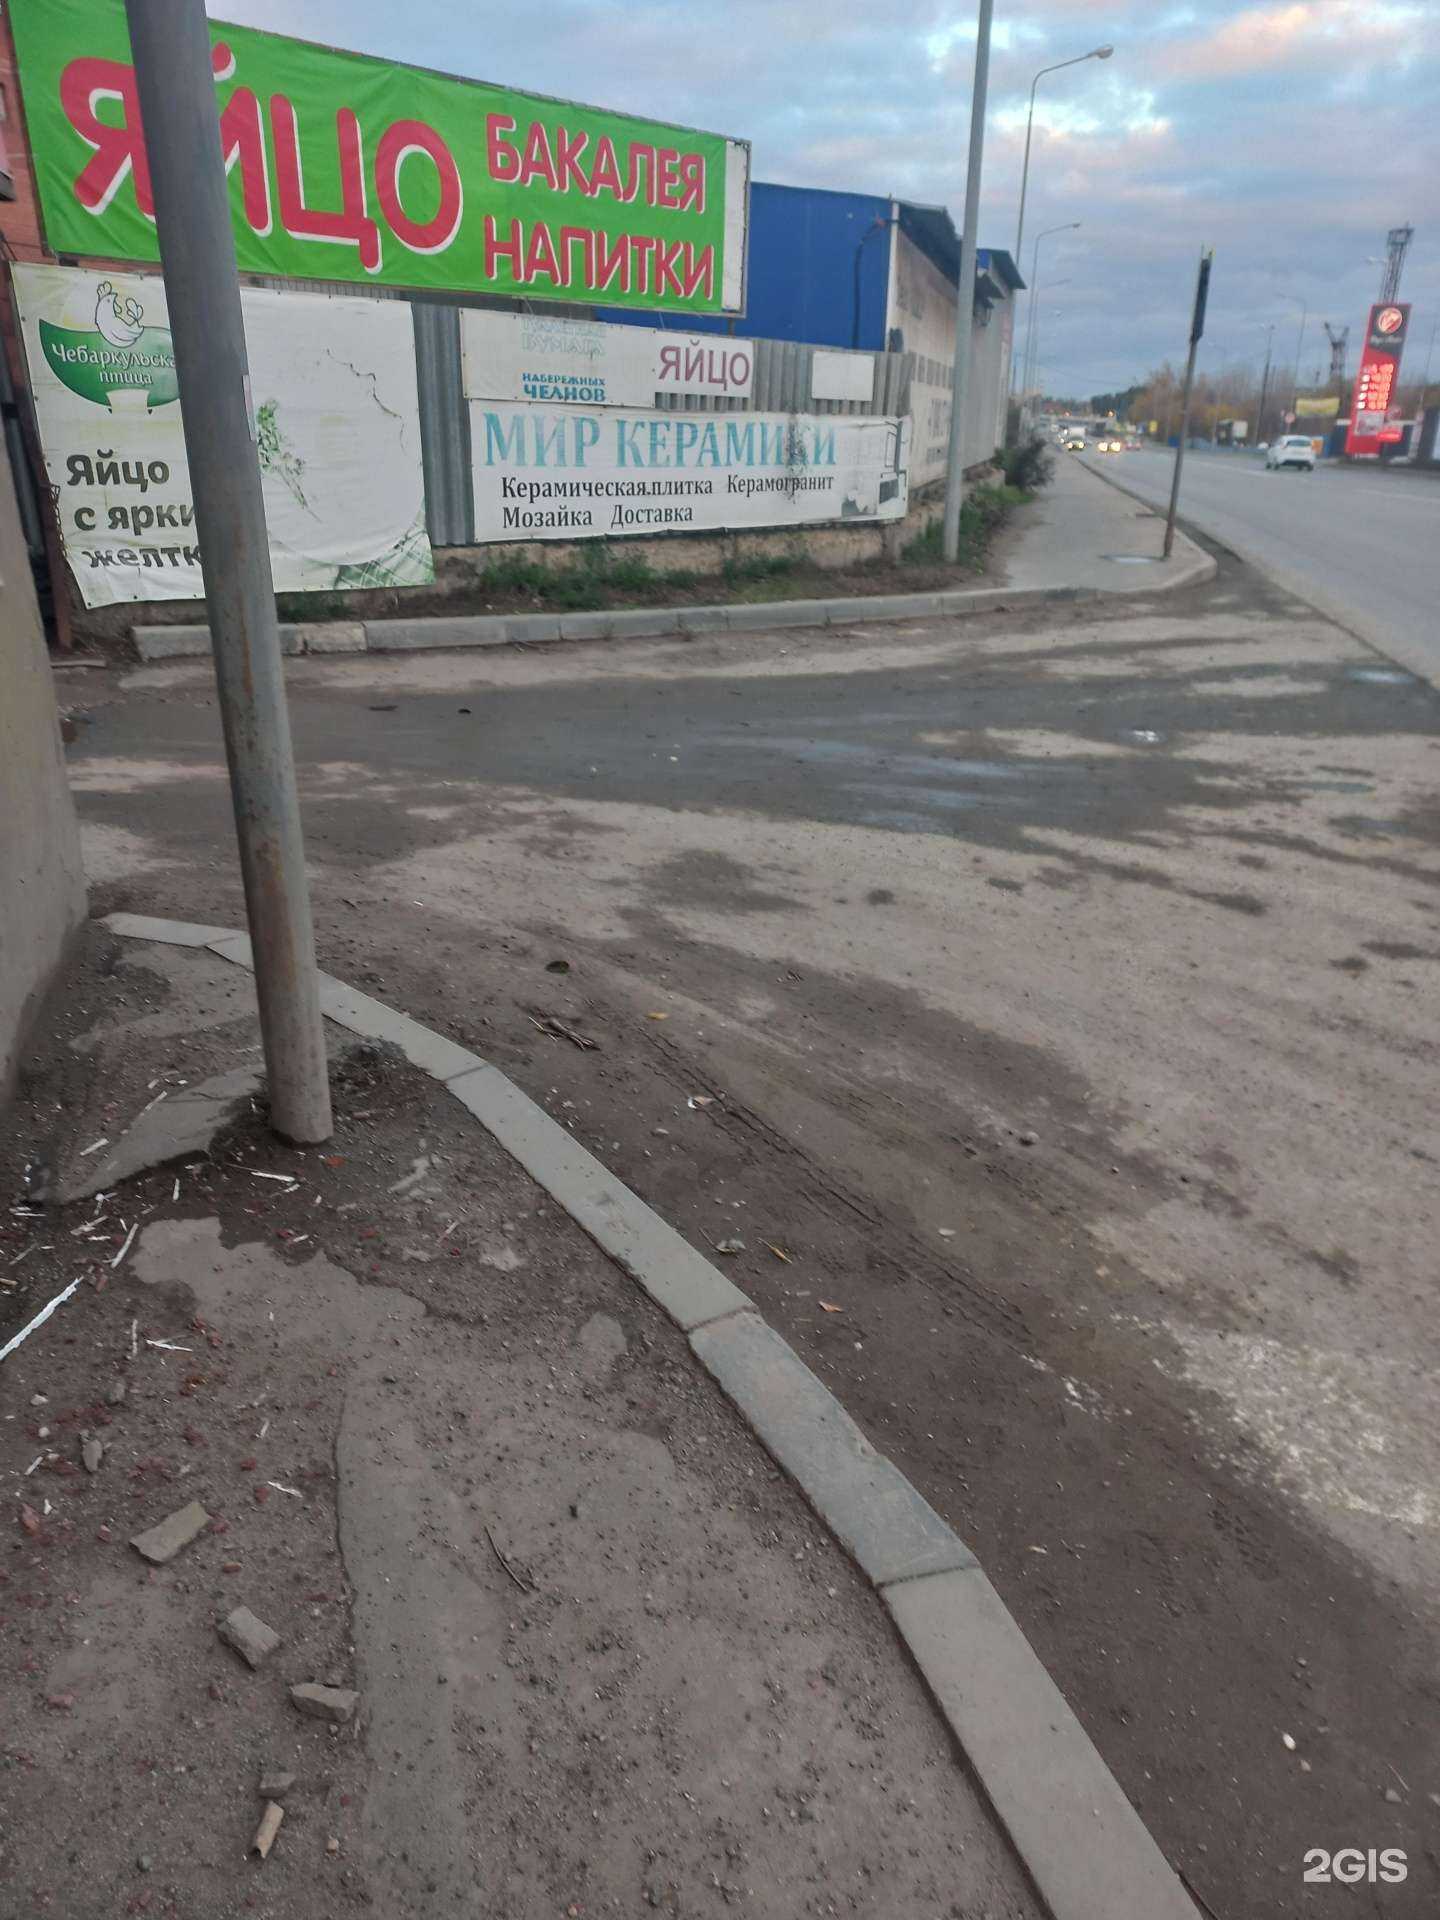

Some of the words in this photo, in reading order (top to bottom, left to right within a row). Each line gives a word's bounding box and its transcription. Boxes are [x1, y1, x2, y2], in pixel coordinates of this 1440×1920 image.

[486, 112, 706, 215] БАКАЛЕЯ
[483, 214, 715, 300] НАПИТКИ
[52, 343, 177, 369] Чебаркульска
[658, 339, 750, 392] ЯЙЦО
[99, 370, 153, 386] птица
[522, 372, 606, 386] НАБЕРЕЖНЫХ
[524, 384, 606, 402] ЧЕЛНОВ
[484, 412, 600, 467] МИР
[66, 449, 170, 492] Яйцо
[727, 475, 834, 497] Керамогранит
[108, 504, 195, 536] ярки
[502, 504, 593, 529] Мозайка
[610, 504, 693, 528] Доставка
[81, 545, 203, 568] желтк
